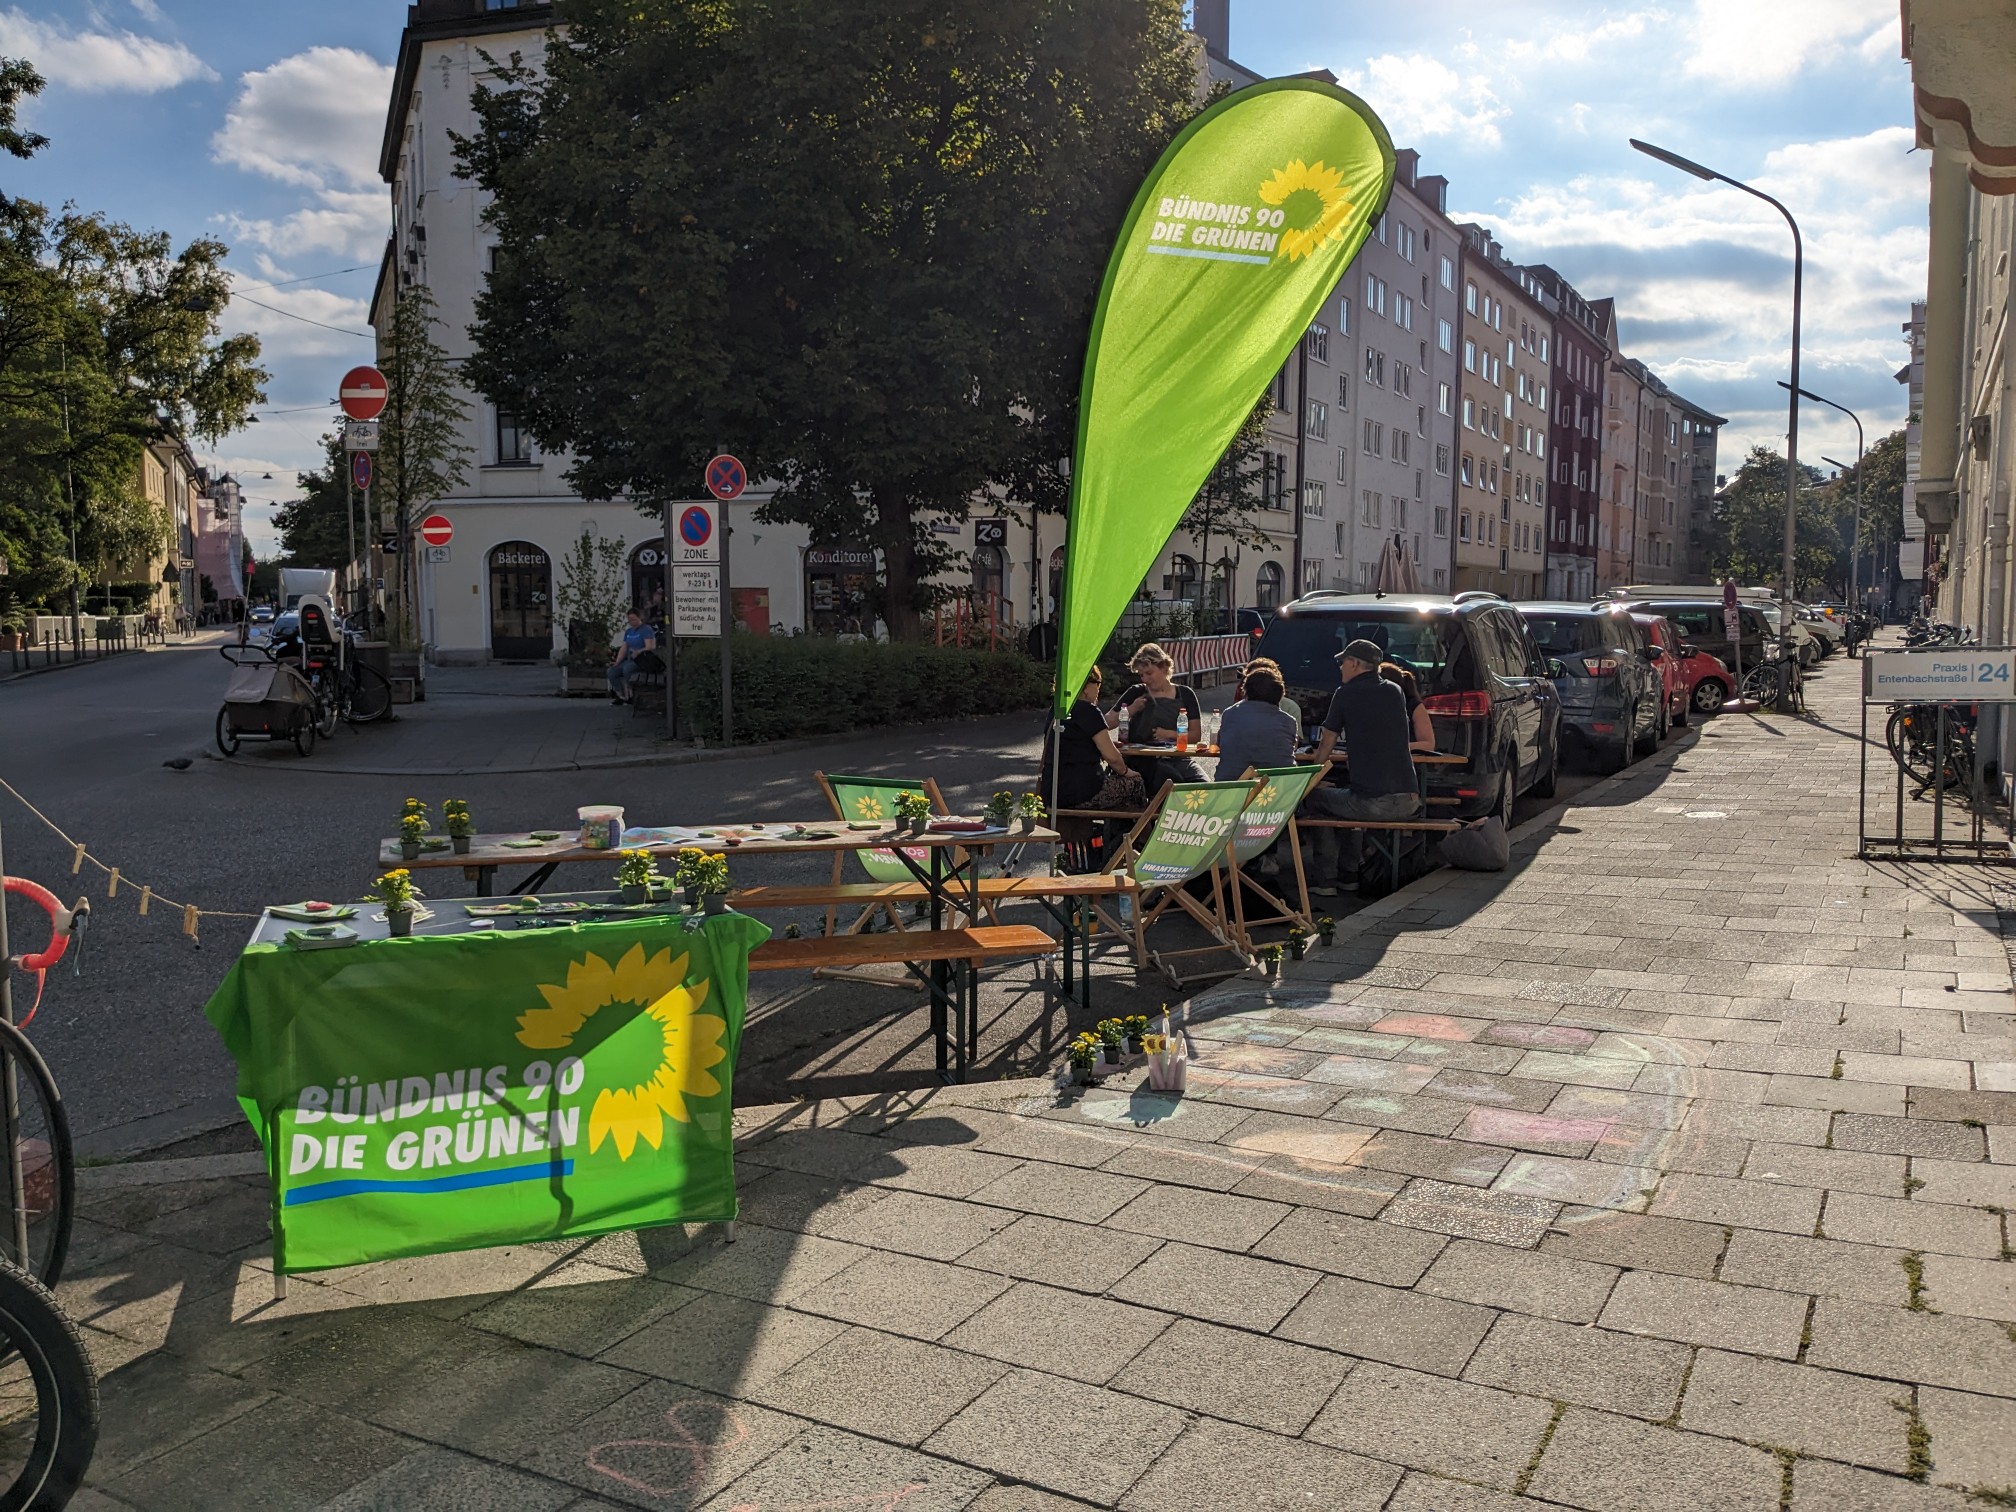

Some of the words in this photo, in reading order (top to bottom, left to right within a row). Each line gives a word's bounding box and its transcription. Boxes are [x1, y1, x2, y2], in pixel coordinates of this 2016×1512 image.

[1158, 194, 1251, 225] BÜNDNIS
[1255, 208, 1285, 228] 90
[1150, 221, 1186, 242] DIE
[1191, 224, 1278, 252] GRÜNEN
[498, 552, 546, 564] Bäckerei
[684, 549, 709, 560] ZONE
[977, 553, 992, 566] Café
[682, 571, 711, 580] werktags
[708, 595, 719, 603] mit
[677, 604, 716, 613] Parkausweis
[679, 614, 704, 622] südliche
[707, 614, 716, 622] Au
[692, 623, 703, 631] frei
[1933, 663, 1967, 672] Praxis
[1977, 663, 2009, 682] 24
[1878, 674, 1967, 684] Entenbachstraße
[294, 1065, 508, 1125] BÜNDNIS
[522, 1056, 585, 1101] 90
[289, 1133, 368, 1176] DIE
[386, 1106, 581, 1171] GRÜNEN
